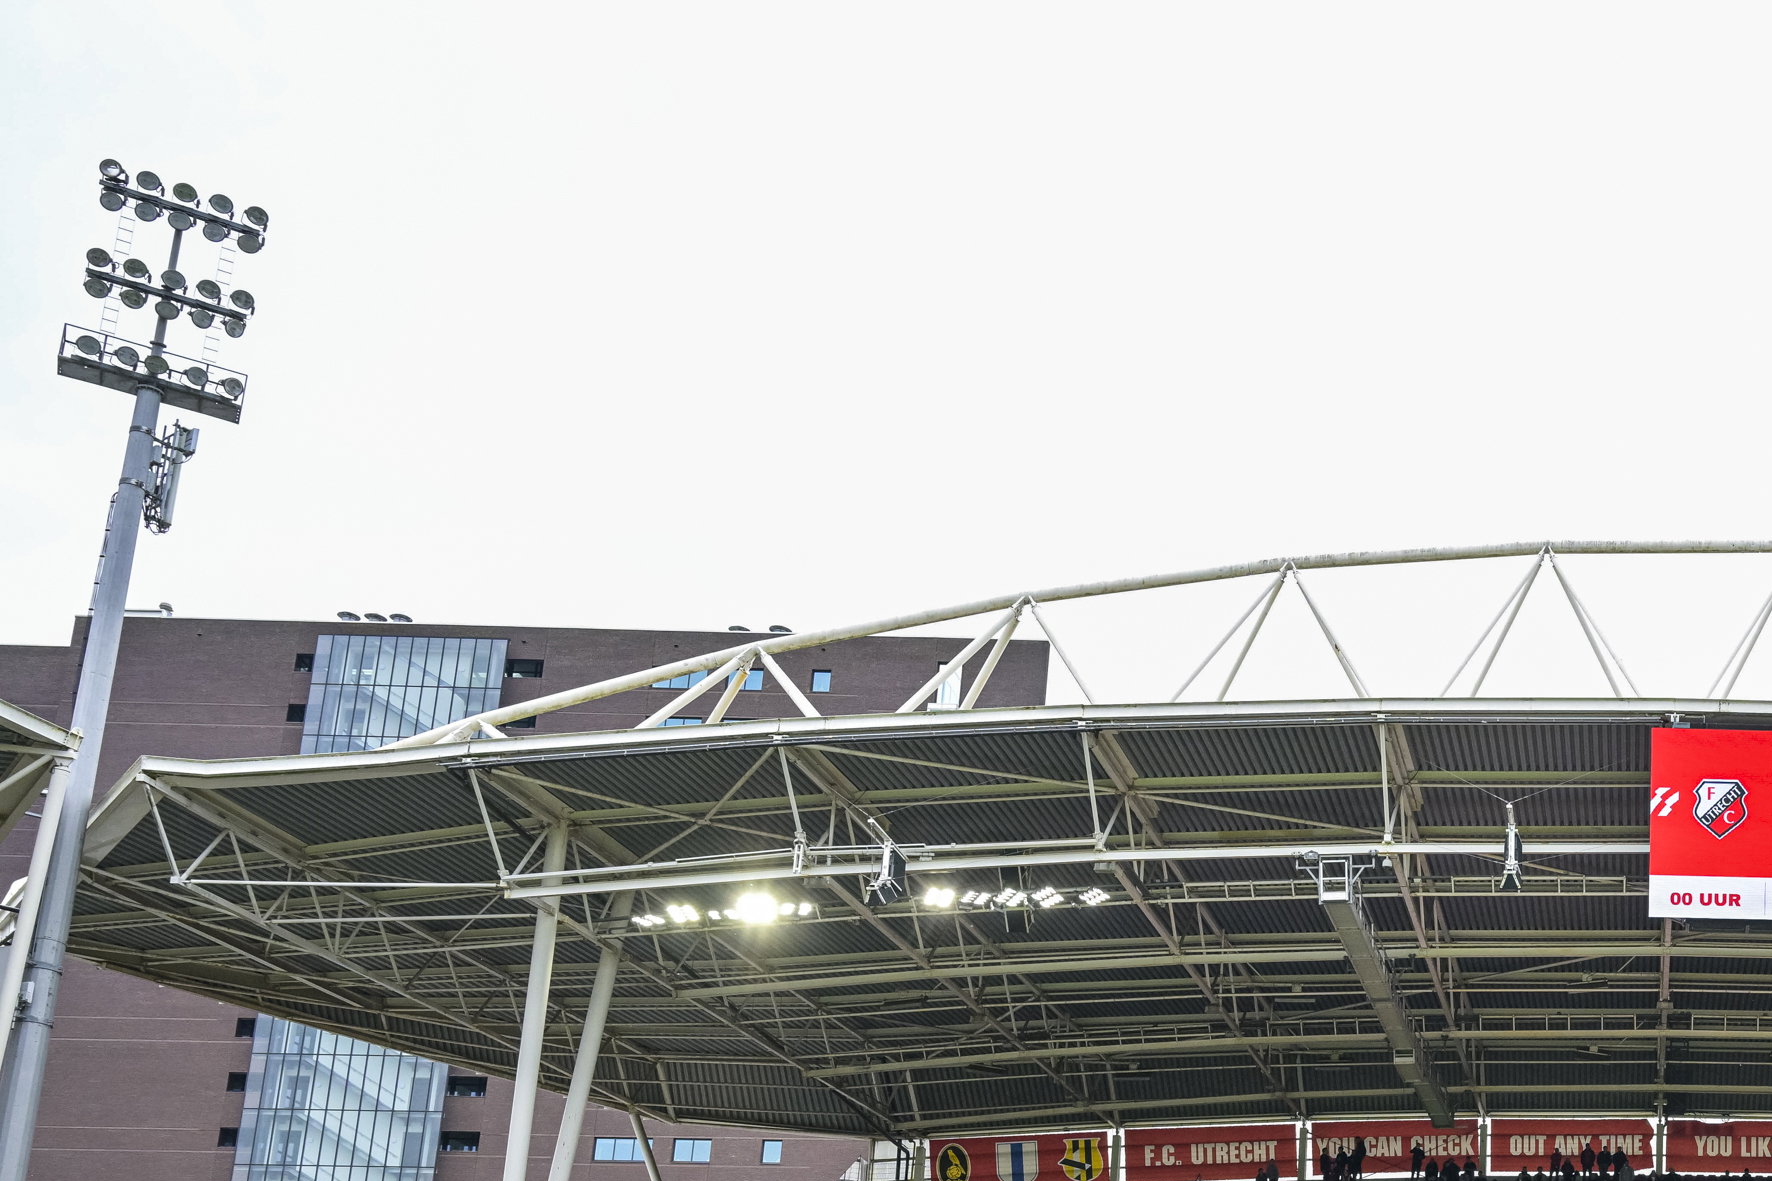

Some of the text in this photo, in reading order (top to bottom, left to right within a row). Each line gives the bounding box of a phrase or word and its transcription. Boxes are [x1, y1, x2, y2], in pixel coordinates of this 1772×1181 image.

[1707, 787, 1716, 800] F
[1701, 785, 1742, 825] UTRECHT
[1723, 810, 1735, 824] C
[1670, 892, 1741, 907] 00 UUR
[1144, 1139, 1278, 1167] F.C. UTRECHT
[1365, 1136, 1402, 1157] CAN
[1410, 1134, 1474, 1156] CHECK
[1510, 1134, 1643, 1156] OUT ANY TIME
[1695, 1136, 1732, 1157] YOU
